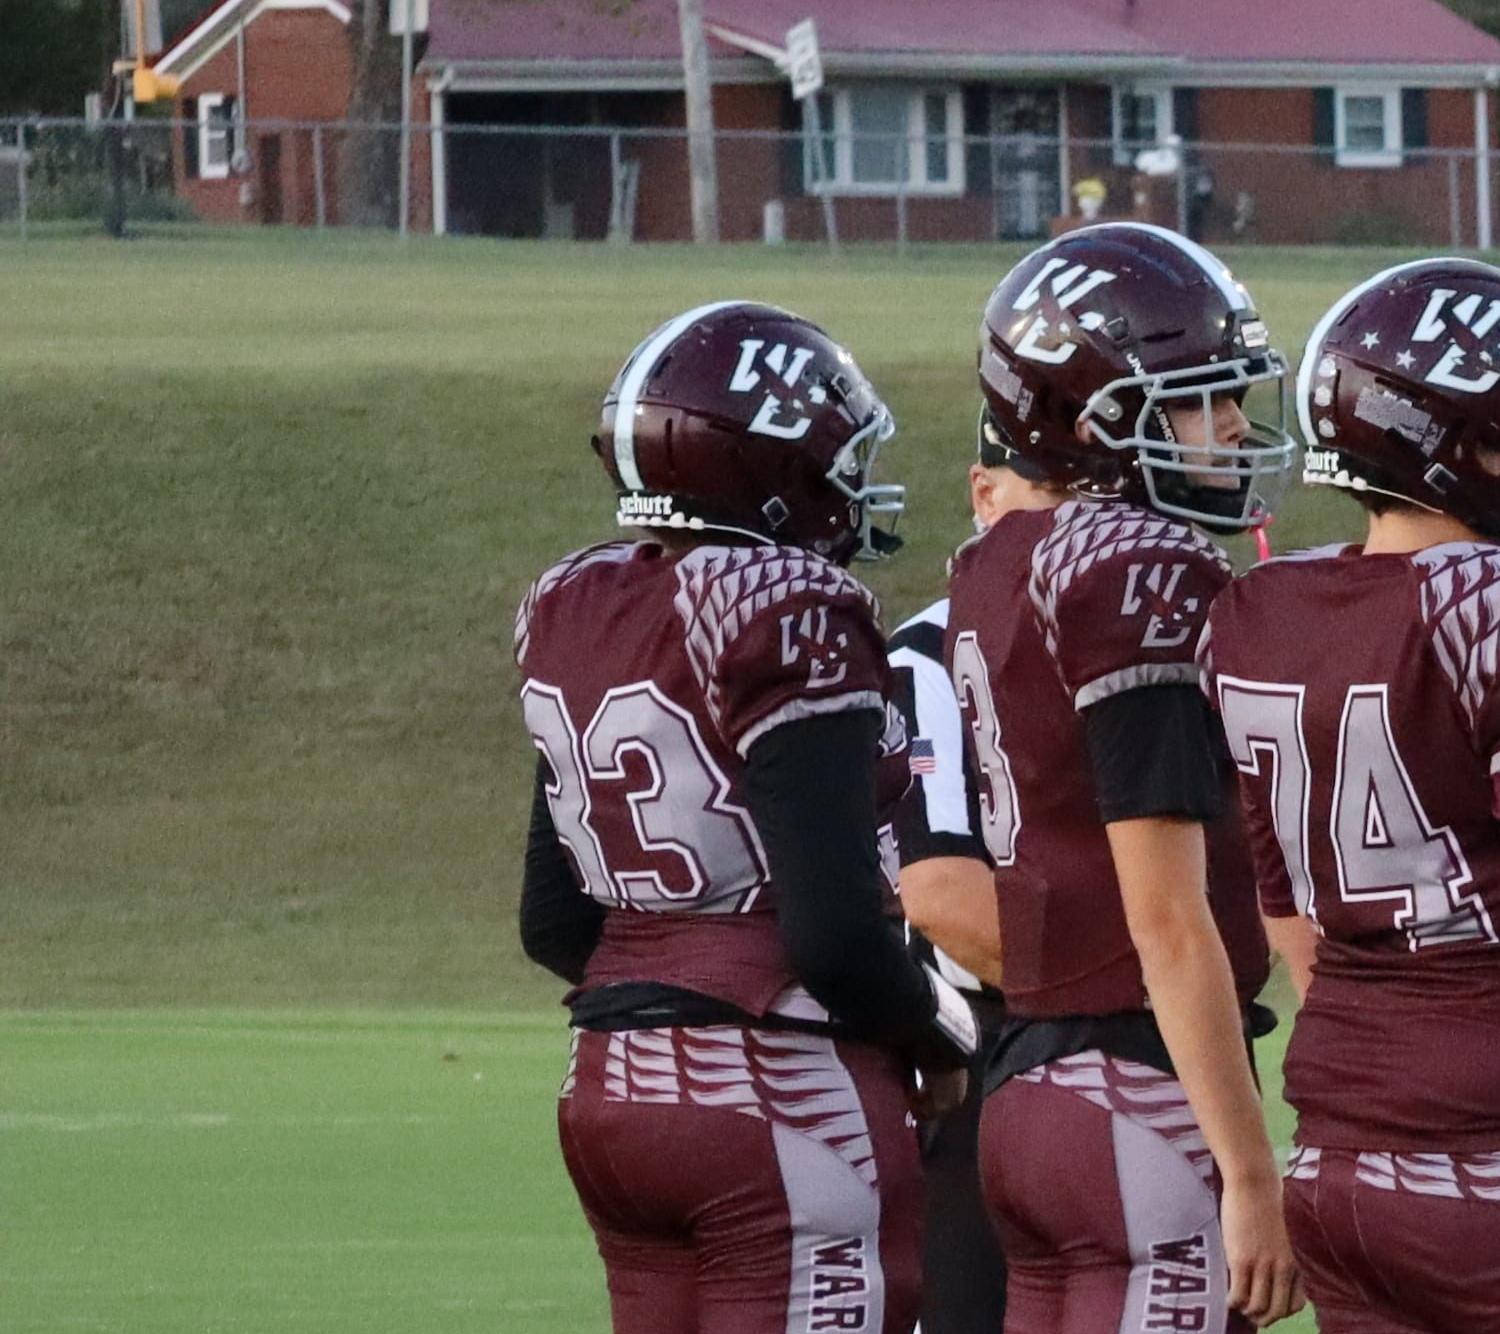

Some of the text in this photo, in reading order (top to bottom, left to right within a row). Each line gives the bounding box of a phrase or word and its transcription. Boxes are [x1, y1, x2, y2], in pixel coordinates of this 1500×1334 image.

[620, 491, 673, 516] schutt
[1216, 674, 1500, 953] 74
[807, 1235, 871, 1333] WAR
[1140, 1232, 1210, 1333] WAR
